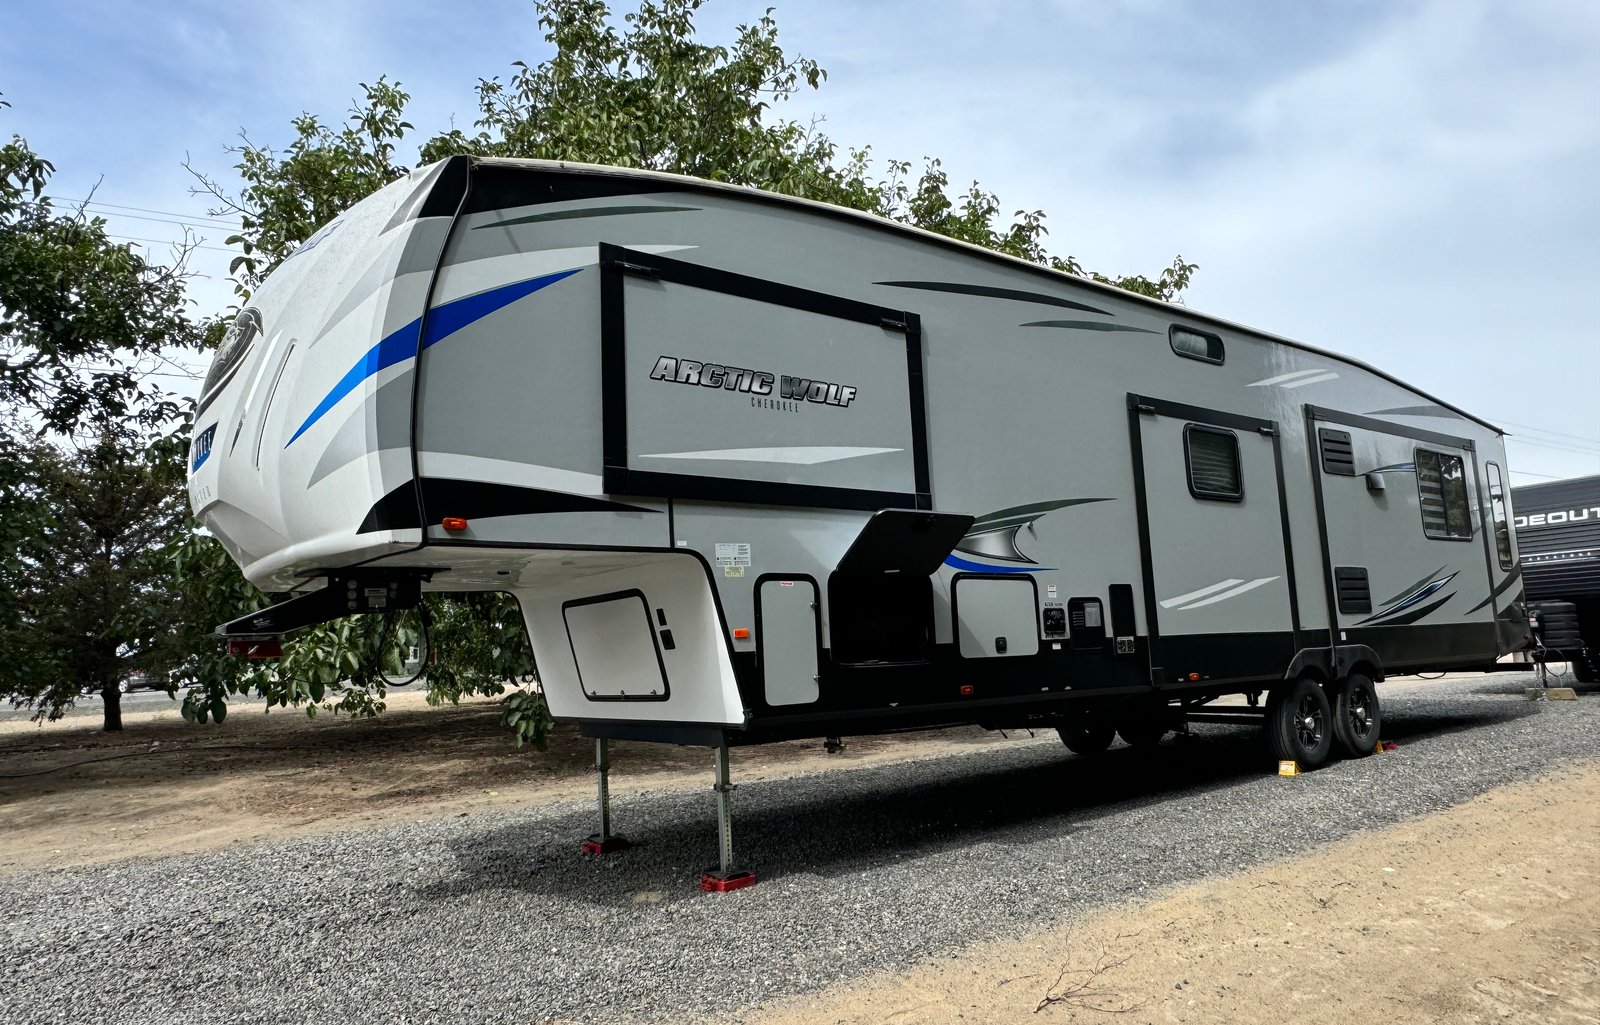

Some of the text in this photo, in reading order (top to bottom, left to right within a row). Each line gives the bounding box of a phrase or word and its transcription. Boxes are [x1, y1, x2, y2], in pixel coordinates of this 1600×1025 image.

[650, 355, 857, 408] ARCTIC WOLF
[750, 396, 799, 413] CHEROKEE
